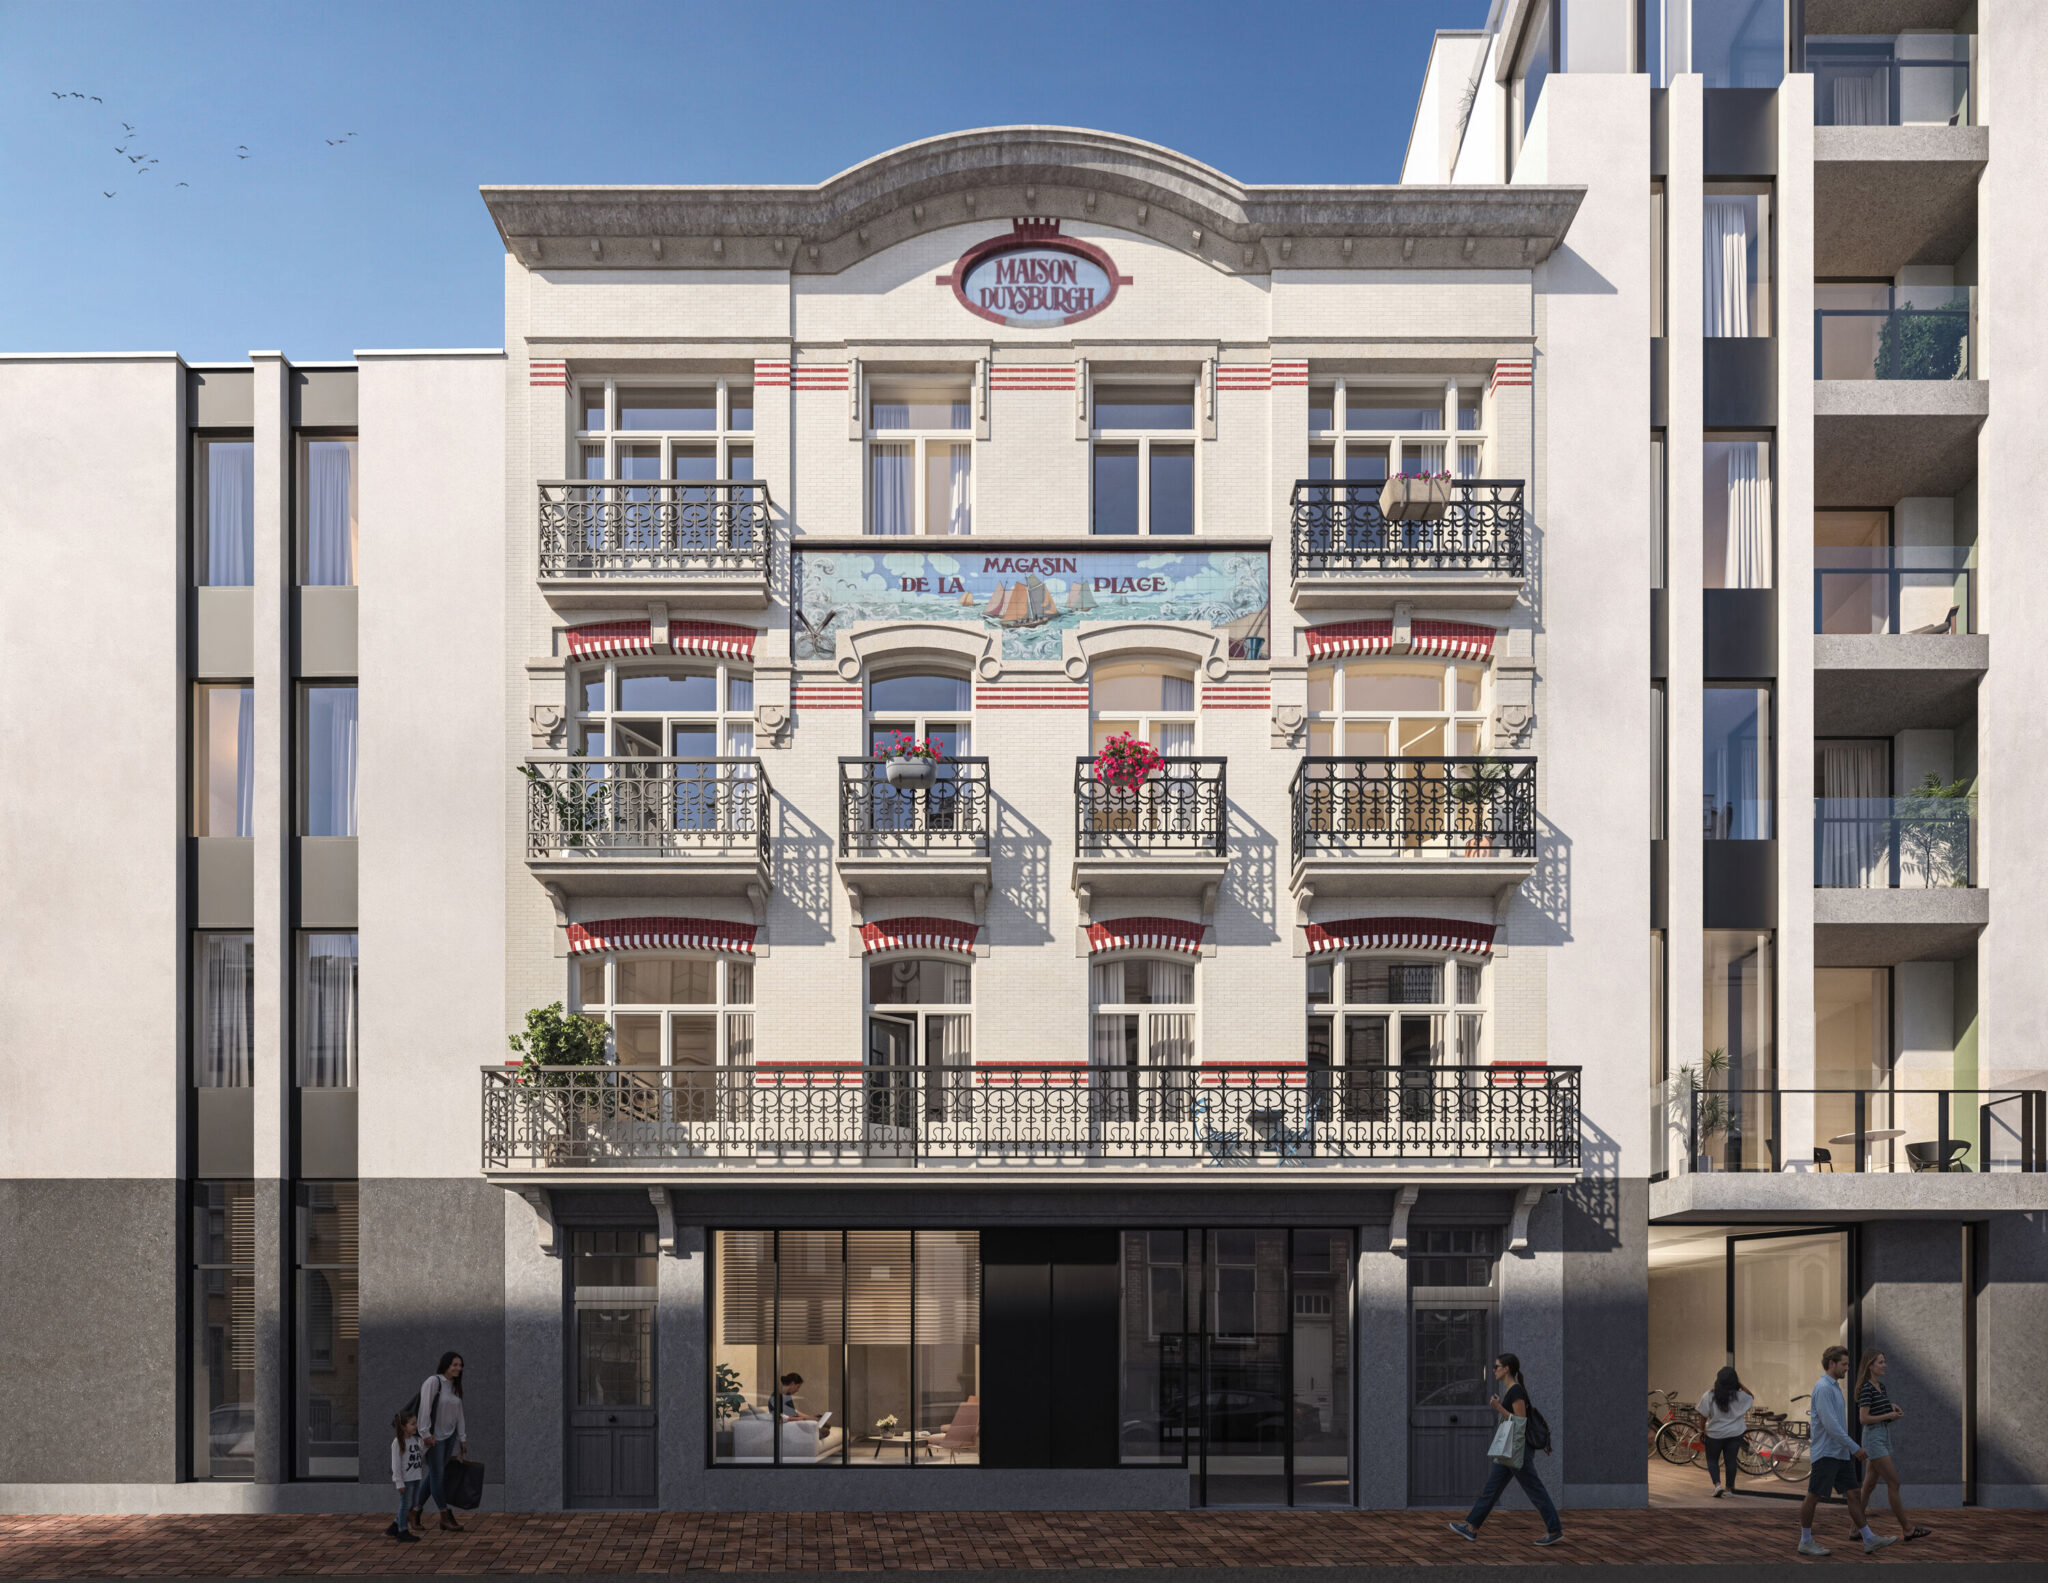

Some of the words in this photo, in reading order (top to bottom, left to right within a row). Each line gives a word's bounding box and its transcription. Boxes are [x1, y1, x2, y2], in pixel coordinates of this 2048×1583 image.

[995, 258, 1078, 285] MAISON
[979, 286, 1095, 314] DUYSBURGH
[982, 558, 1077, 576] MAGASIN
[901, 577, 931, 592] DE
[937, 577, 965, 594] LA
[1093, 576, 1168, 594] PLAGE
